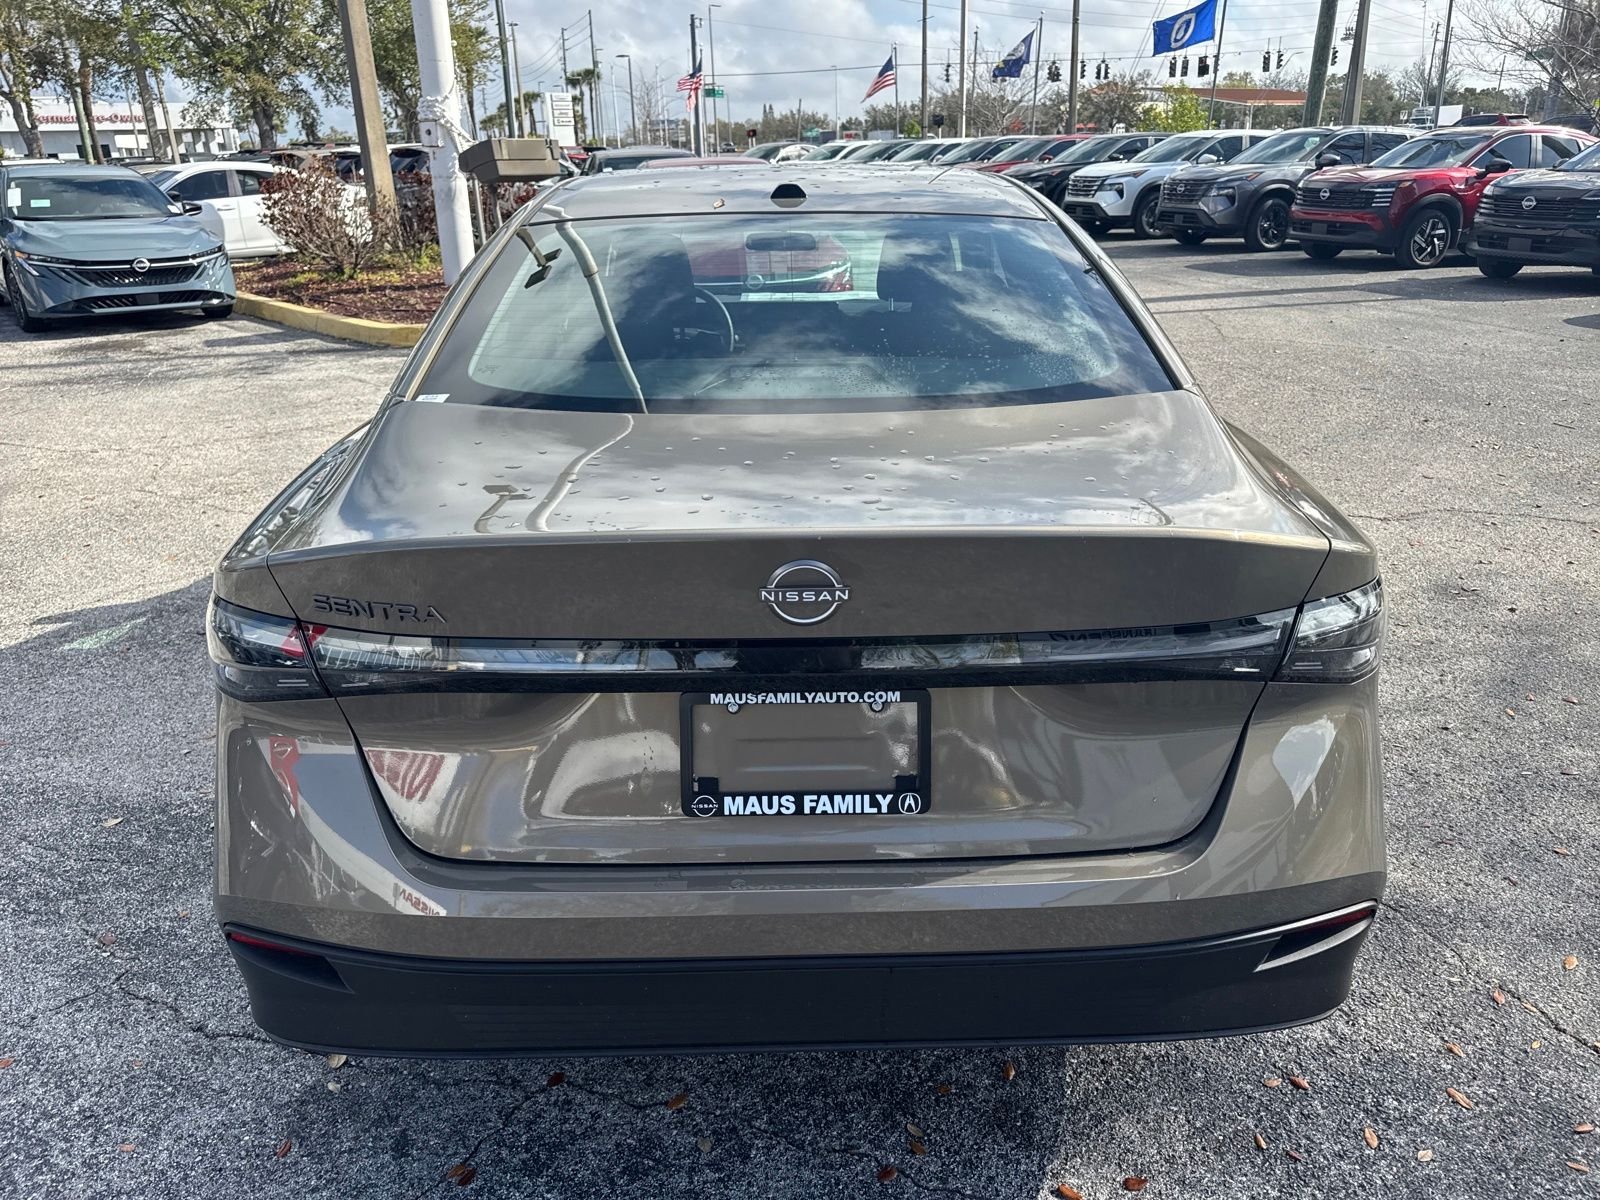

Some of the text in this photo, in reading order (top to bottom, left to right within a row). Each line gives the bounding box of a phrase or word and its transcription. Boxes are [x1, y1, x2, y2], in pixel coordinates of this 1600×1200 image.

[761, 589, 849, 602] NISSAN
[312, 593, 447, 624] SENTRA
[710, 690, 901, 705] MAUSFAMILYAUTO.COM
[723, 793, 894, 816] MAUS FAMILY
